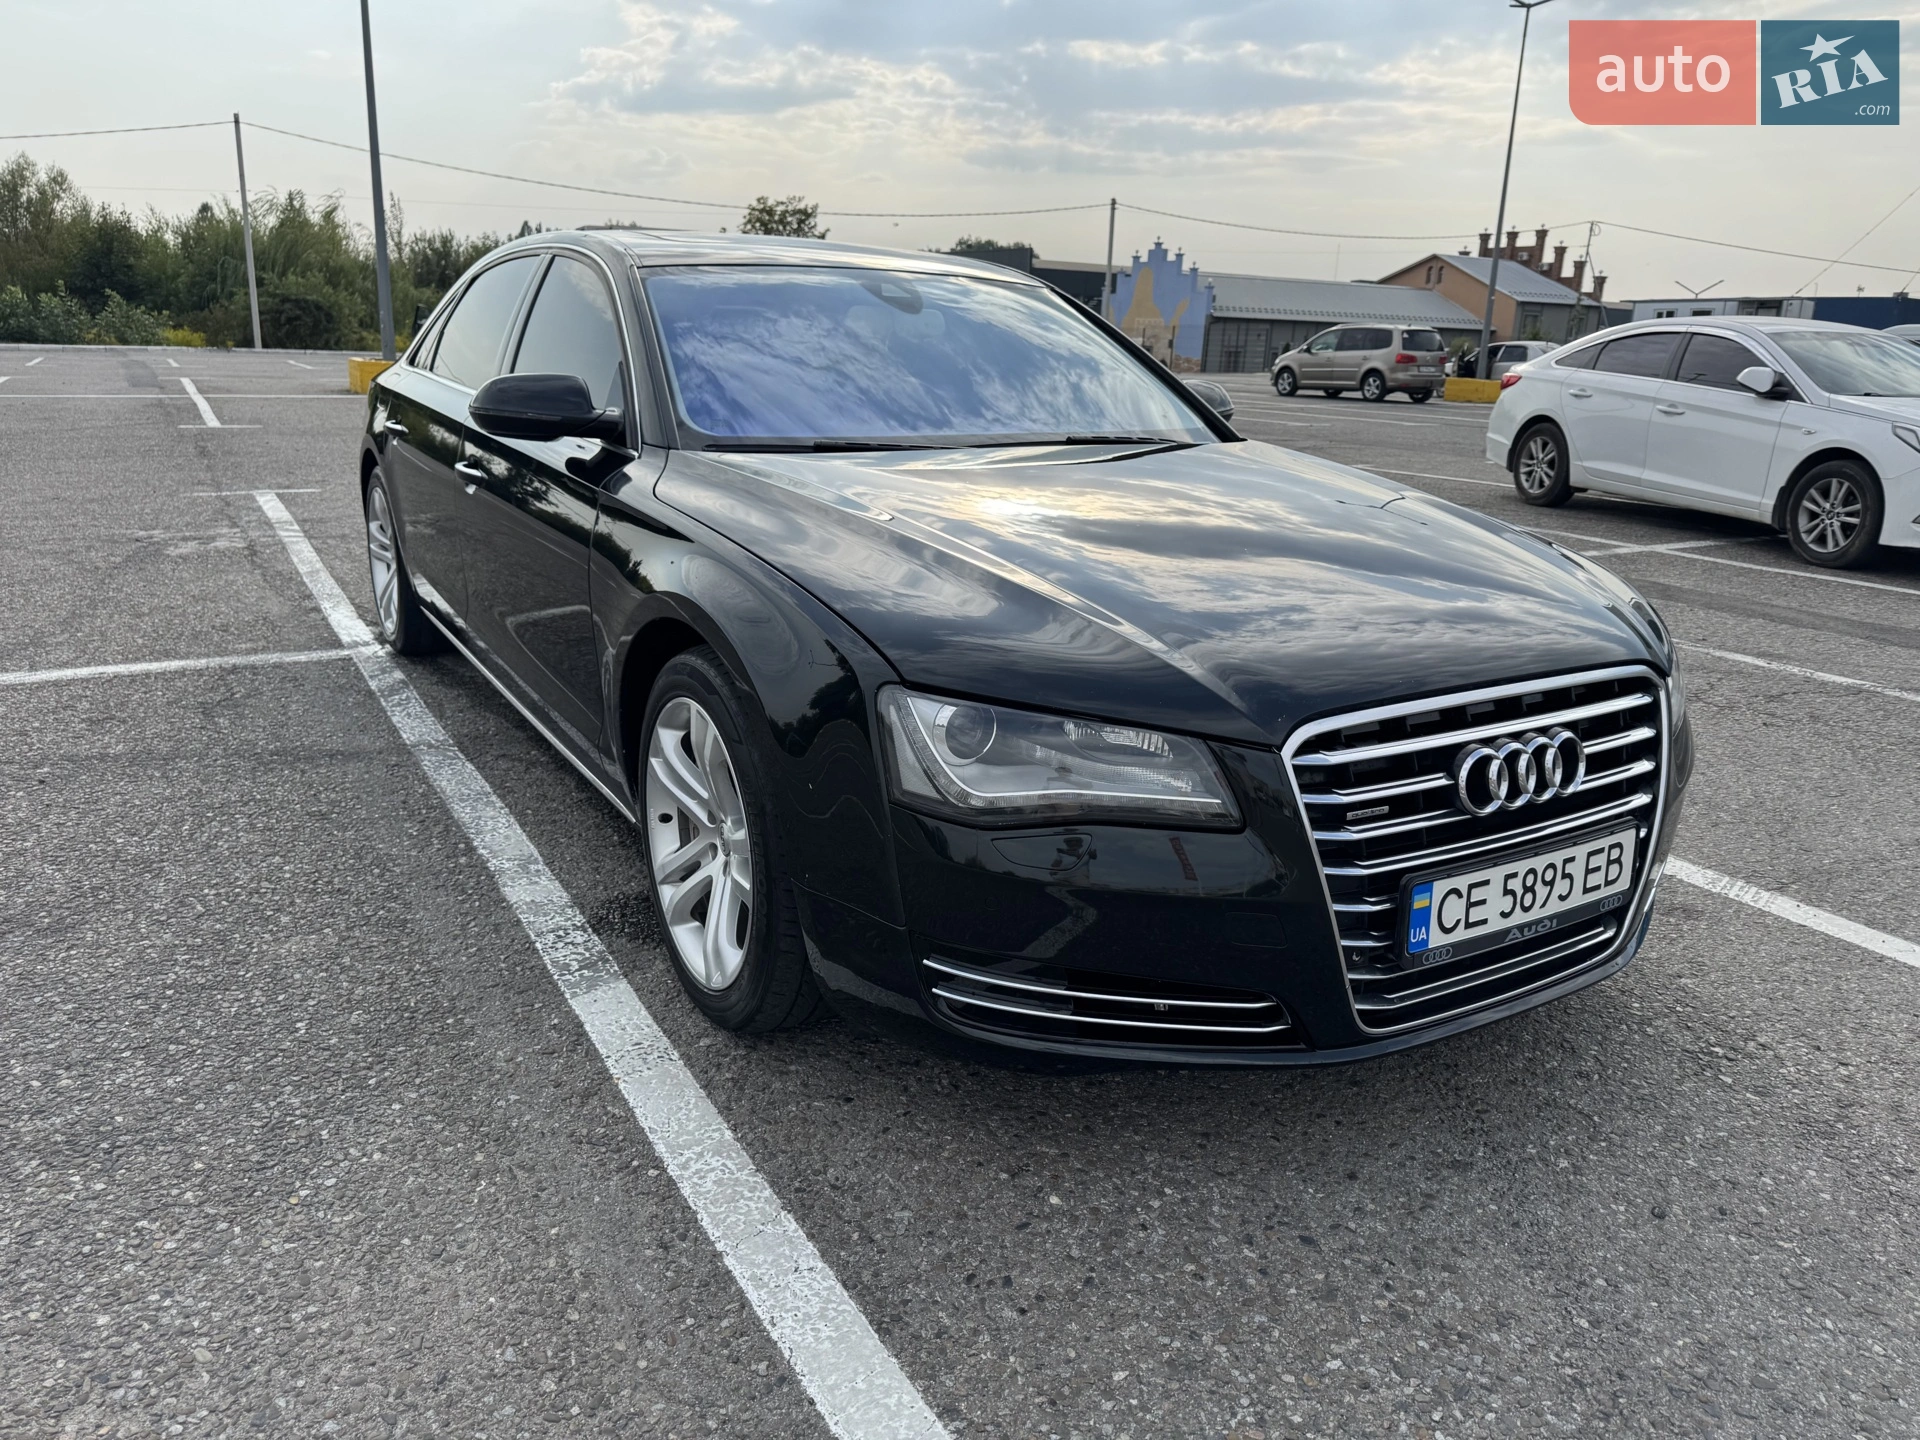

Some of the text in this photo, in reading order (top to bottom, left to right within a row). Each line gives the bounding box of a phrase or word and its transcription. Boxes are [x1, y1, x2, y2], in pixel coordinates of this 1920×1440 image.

[1437, 841, 1624, 935] CE 5895 EB
[1410, 926, 1427, 942] UA
[1504, 918, 1558, 942] Audi
